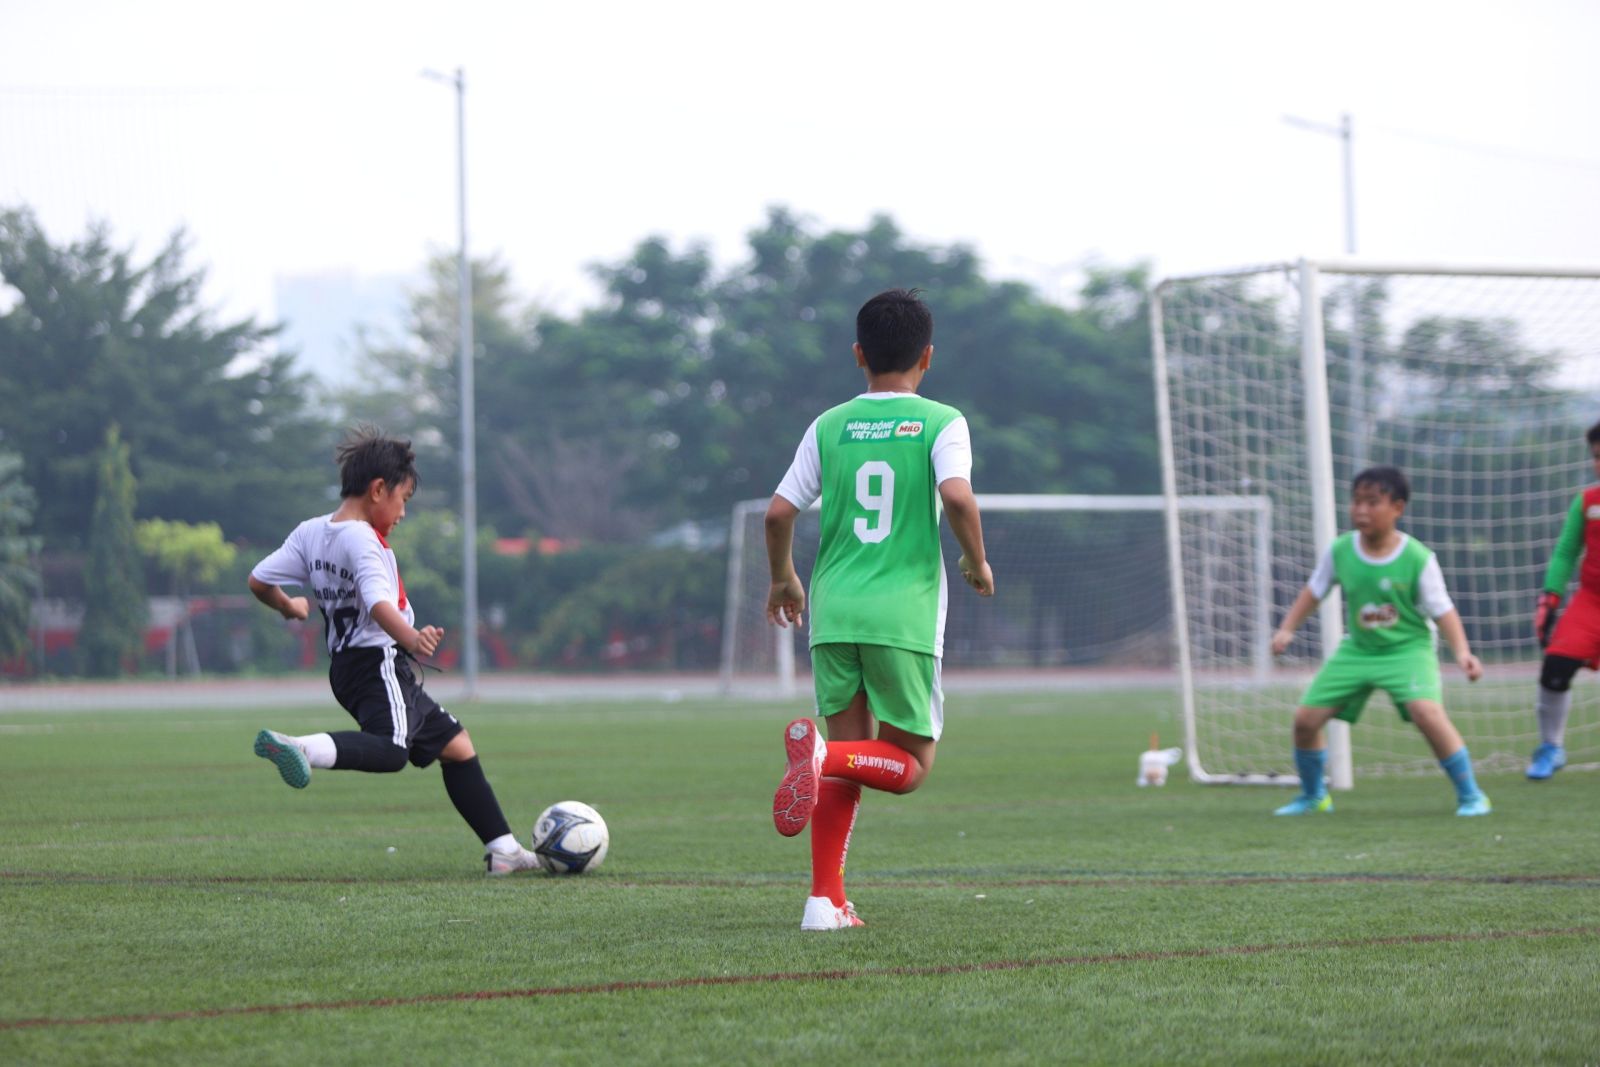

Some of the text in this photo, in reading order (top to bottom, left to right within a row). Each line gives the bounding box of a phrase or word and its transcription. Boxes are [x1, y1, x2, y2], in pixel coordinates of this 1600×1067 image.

[898, 425, 921, 433] MILO
[872, 430, 892, 439] NAM
[853, 461, 895, 543] 9
